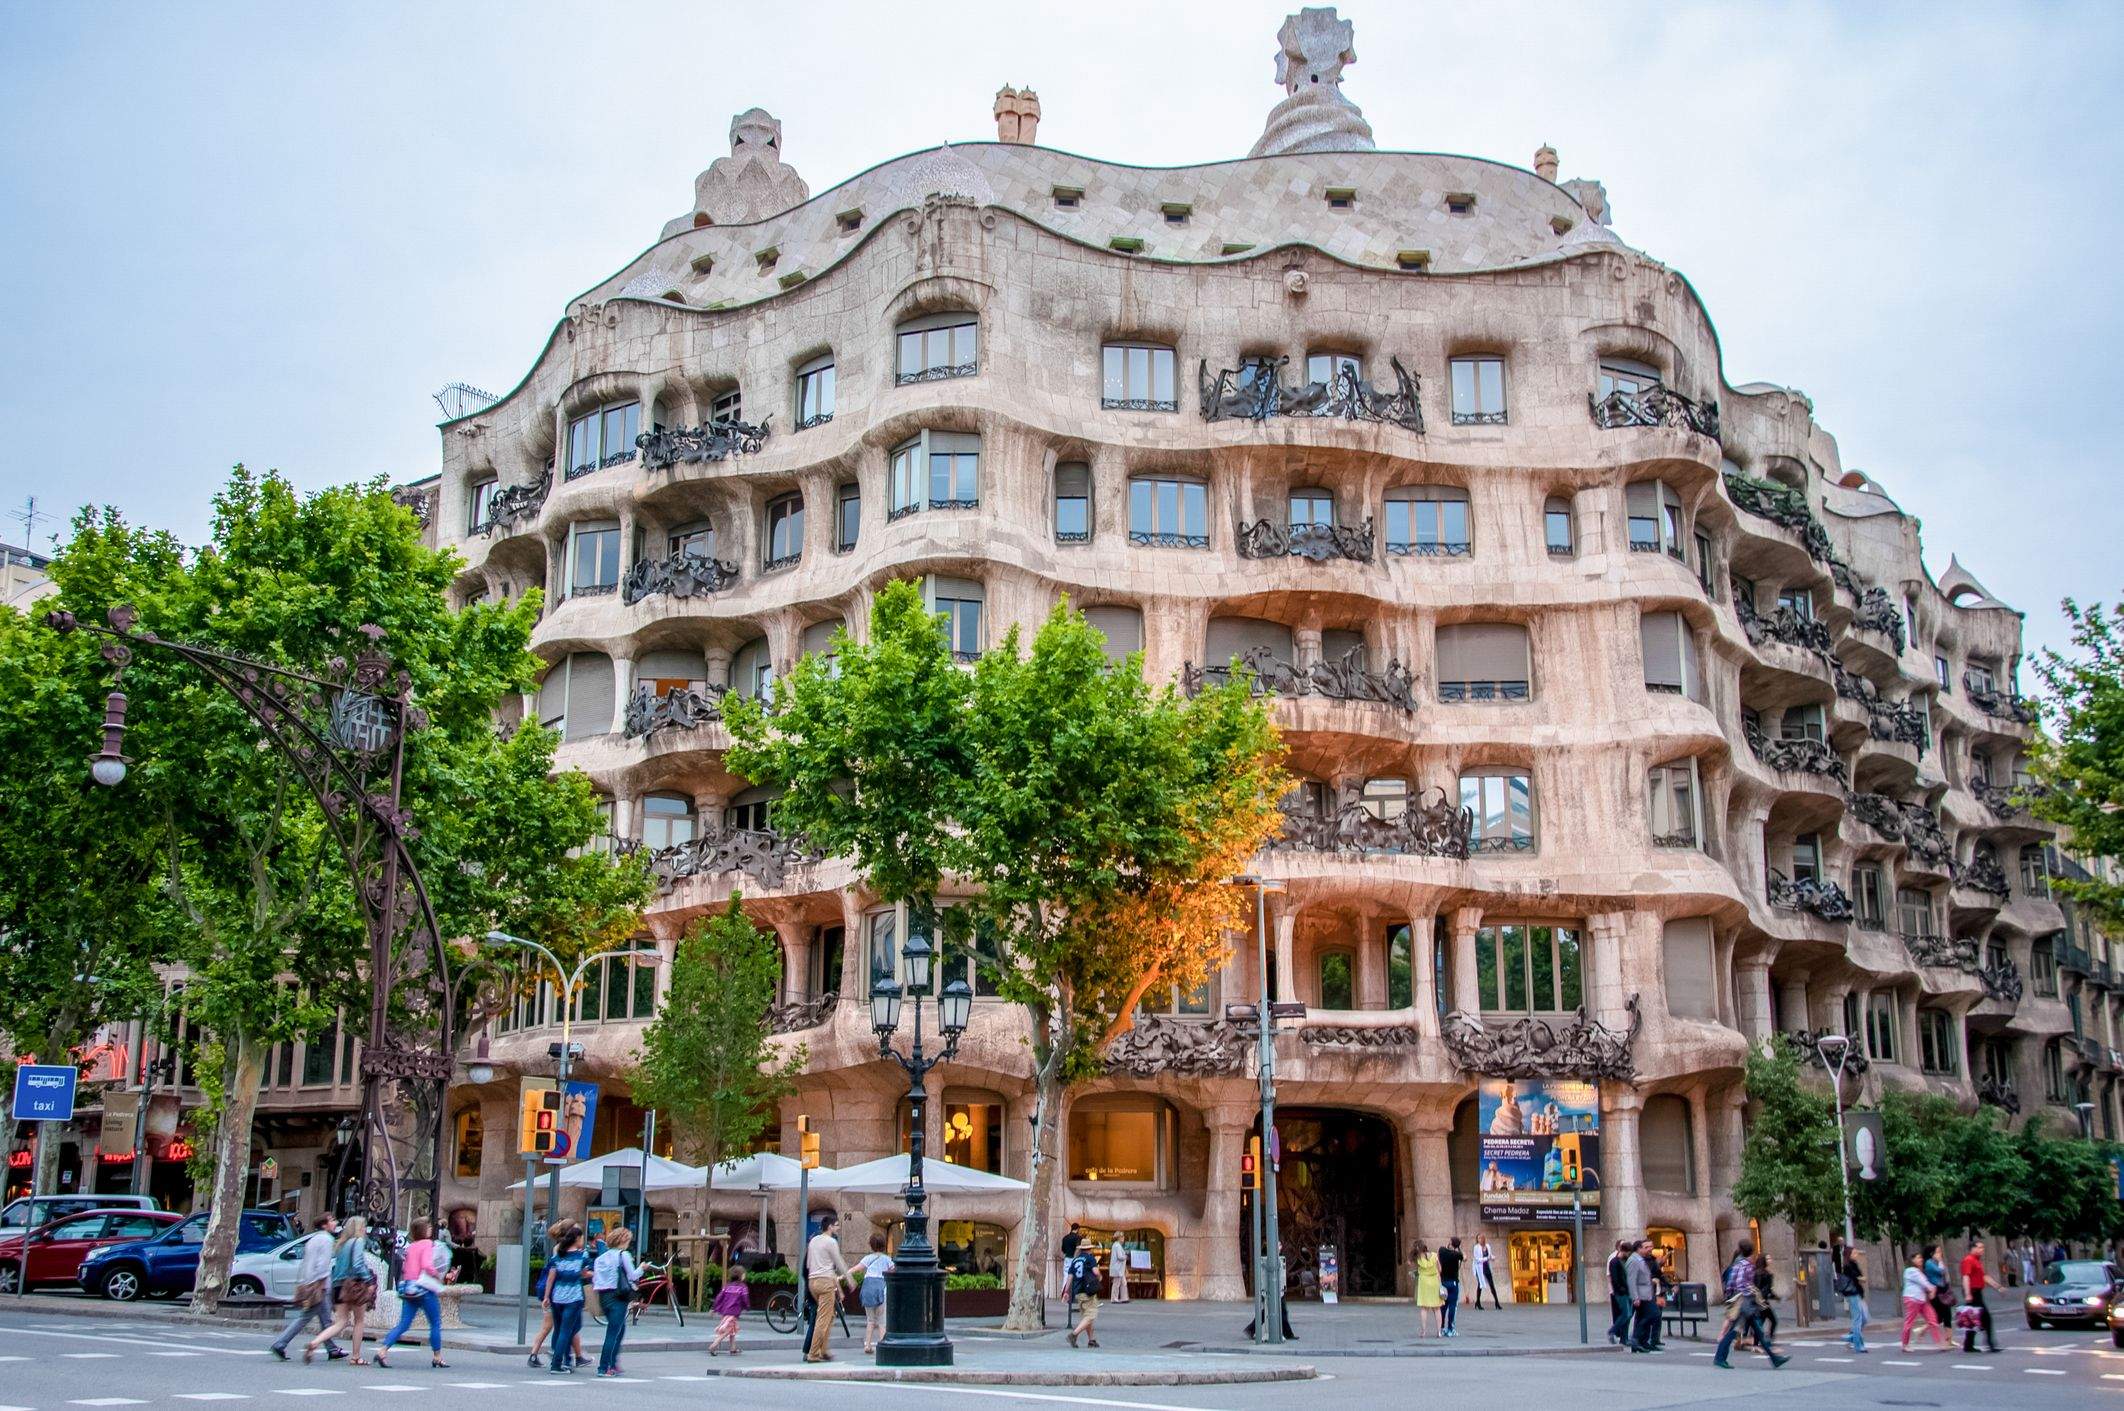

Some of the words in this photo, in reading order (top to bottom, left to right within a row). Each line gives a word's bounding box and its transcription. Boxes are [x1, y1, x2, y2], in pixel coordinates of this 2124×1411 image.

[33, 1100, 55, 1111] taxi
[1483, 1206, 1507, 1214] Chema
[1507, 1206, 1530, 1214] Madoz
